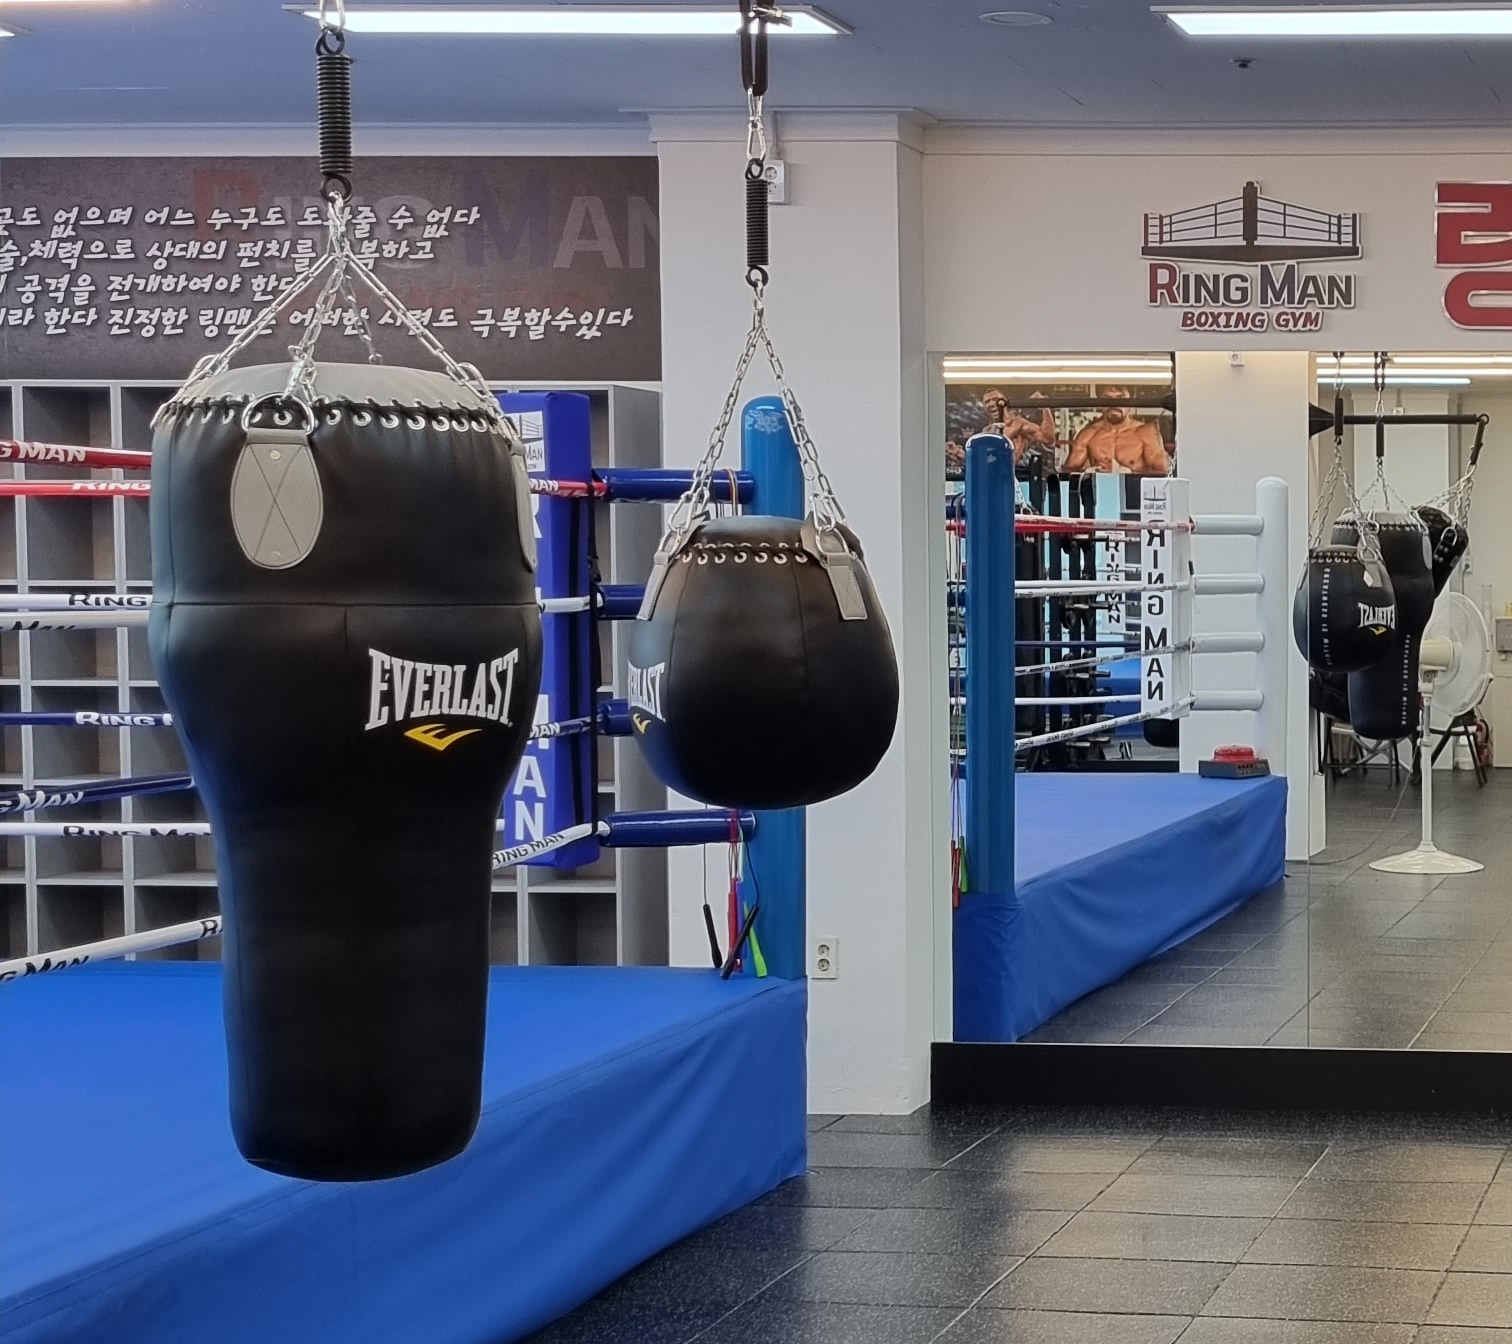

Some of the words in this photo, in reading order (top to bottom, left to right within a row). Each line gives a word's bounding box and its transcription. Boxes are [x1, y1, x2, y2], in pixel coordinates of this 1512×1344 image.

[50, 206, 133, 238] 없으며
[144, 206, 195, 226] 어느
[207, 207, 285, 230] 누구도
[388, 206, 414, 230] 수
[423, 206, 481, 238] 없다
[146, 240, 228, 271] 상대의
[237, 239, 317, 273] 펀치를
[337, 239, 435, 270] 복하고
[16, 273, 96, 306] 공격을
[106, 273, 242, 302] 전개하여야
[1149, 262, 1249, 306] RING
[1259, 263, 1353, 306] MAN
[44, 307, 97, 335] 한다
[107, 307, 188, 337] 진정한
[1181, 311, 1266, 330] BOXING
[1275, 311, 1322, 329] GYM
[69, 593, 147, 607] RING
[365, 648, 519, 730] EVERLAST
[75, 711, 155, 726] RING
